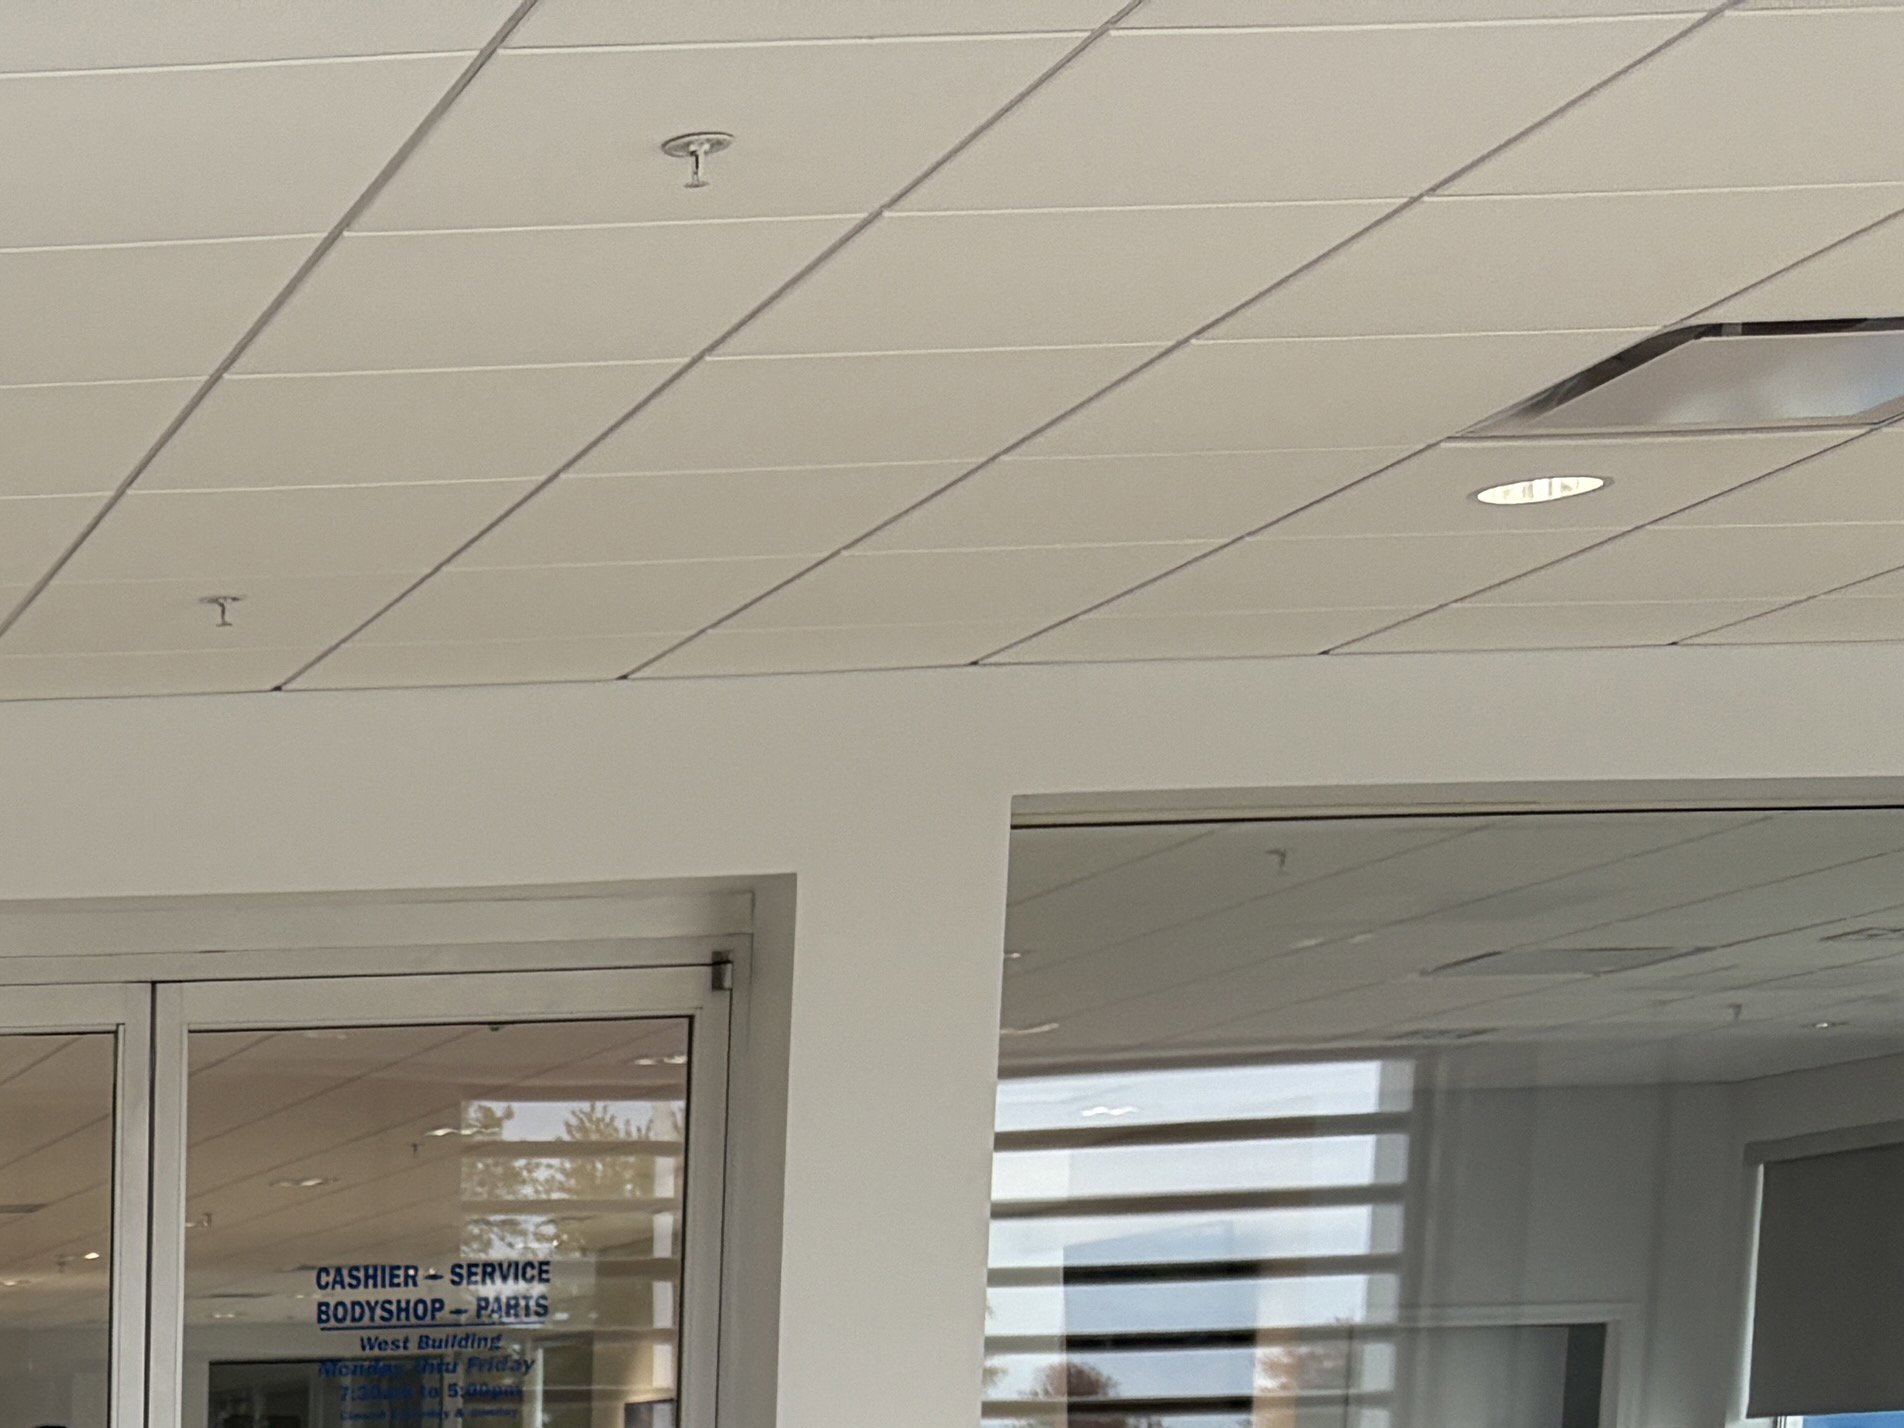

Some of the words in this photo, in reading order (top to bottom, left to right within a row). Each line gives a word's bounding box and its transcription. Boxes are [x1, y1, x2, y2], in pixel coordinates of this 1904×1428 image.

[315, 1265, 419, 1291] CASHIER
[450, 1261, 551, 1286] SERVICE
[317, 1298, 445, 1324] BODYSHOP
[475, 1295, 549, 1319] PARTS
[360, 1336, 410, 1352] West
[417, 1333, 503, 1351] Building
[467, 1356, 535, 1377] Friday
